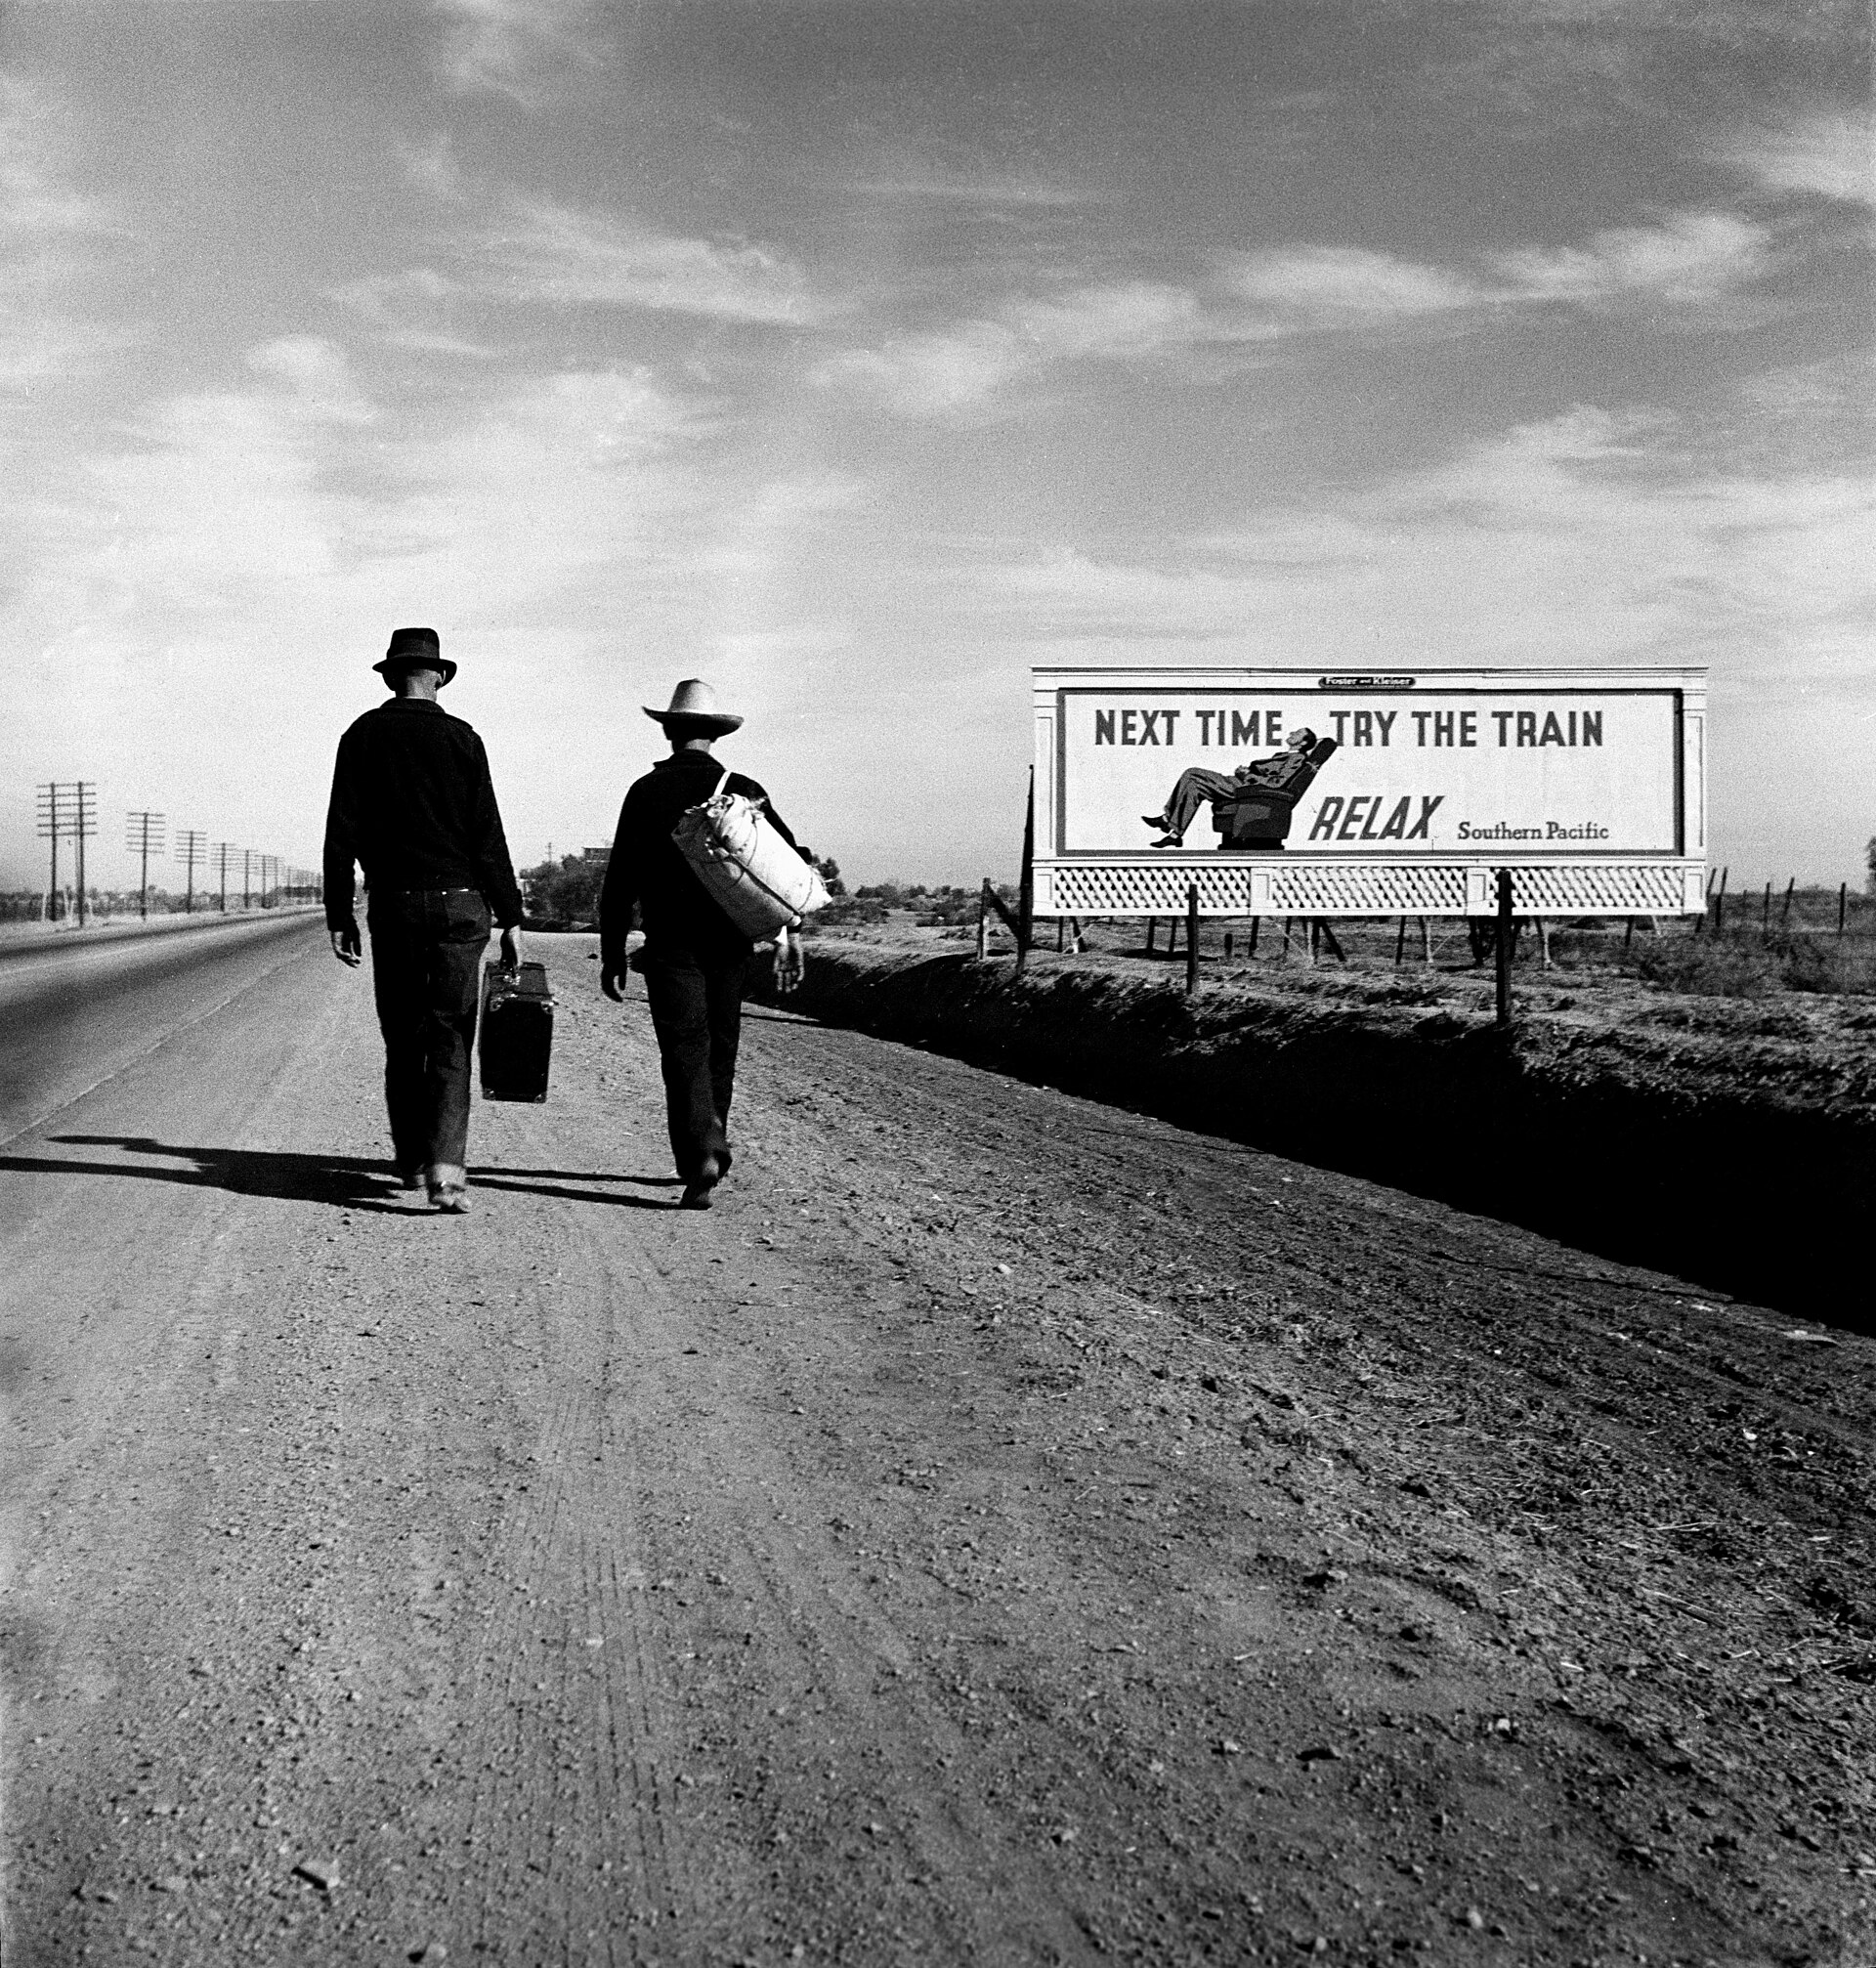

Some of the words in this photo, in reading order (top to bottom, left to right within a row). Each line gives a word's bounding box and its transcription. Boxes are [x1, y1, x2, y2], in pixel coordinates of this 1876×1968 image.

[1326, 676, 1357, 685] Foster
[1095, 709, 1180, 746] NEXT
[1196, 710, 1282, 747] TIME
[1330, 710, 1397, 747] TRY
[1411, 710, 1476, 747] THE
[1492, 710, 1603, 747] TRAIN
[1308, 796, 1444, 840] RELAX
[1458, 821, 1542, 840] Southern
[1547, 821, 1608, 840] Pacific
